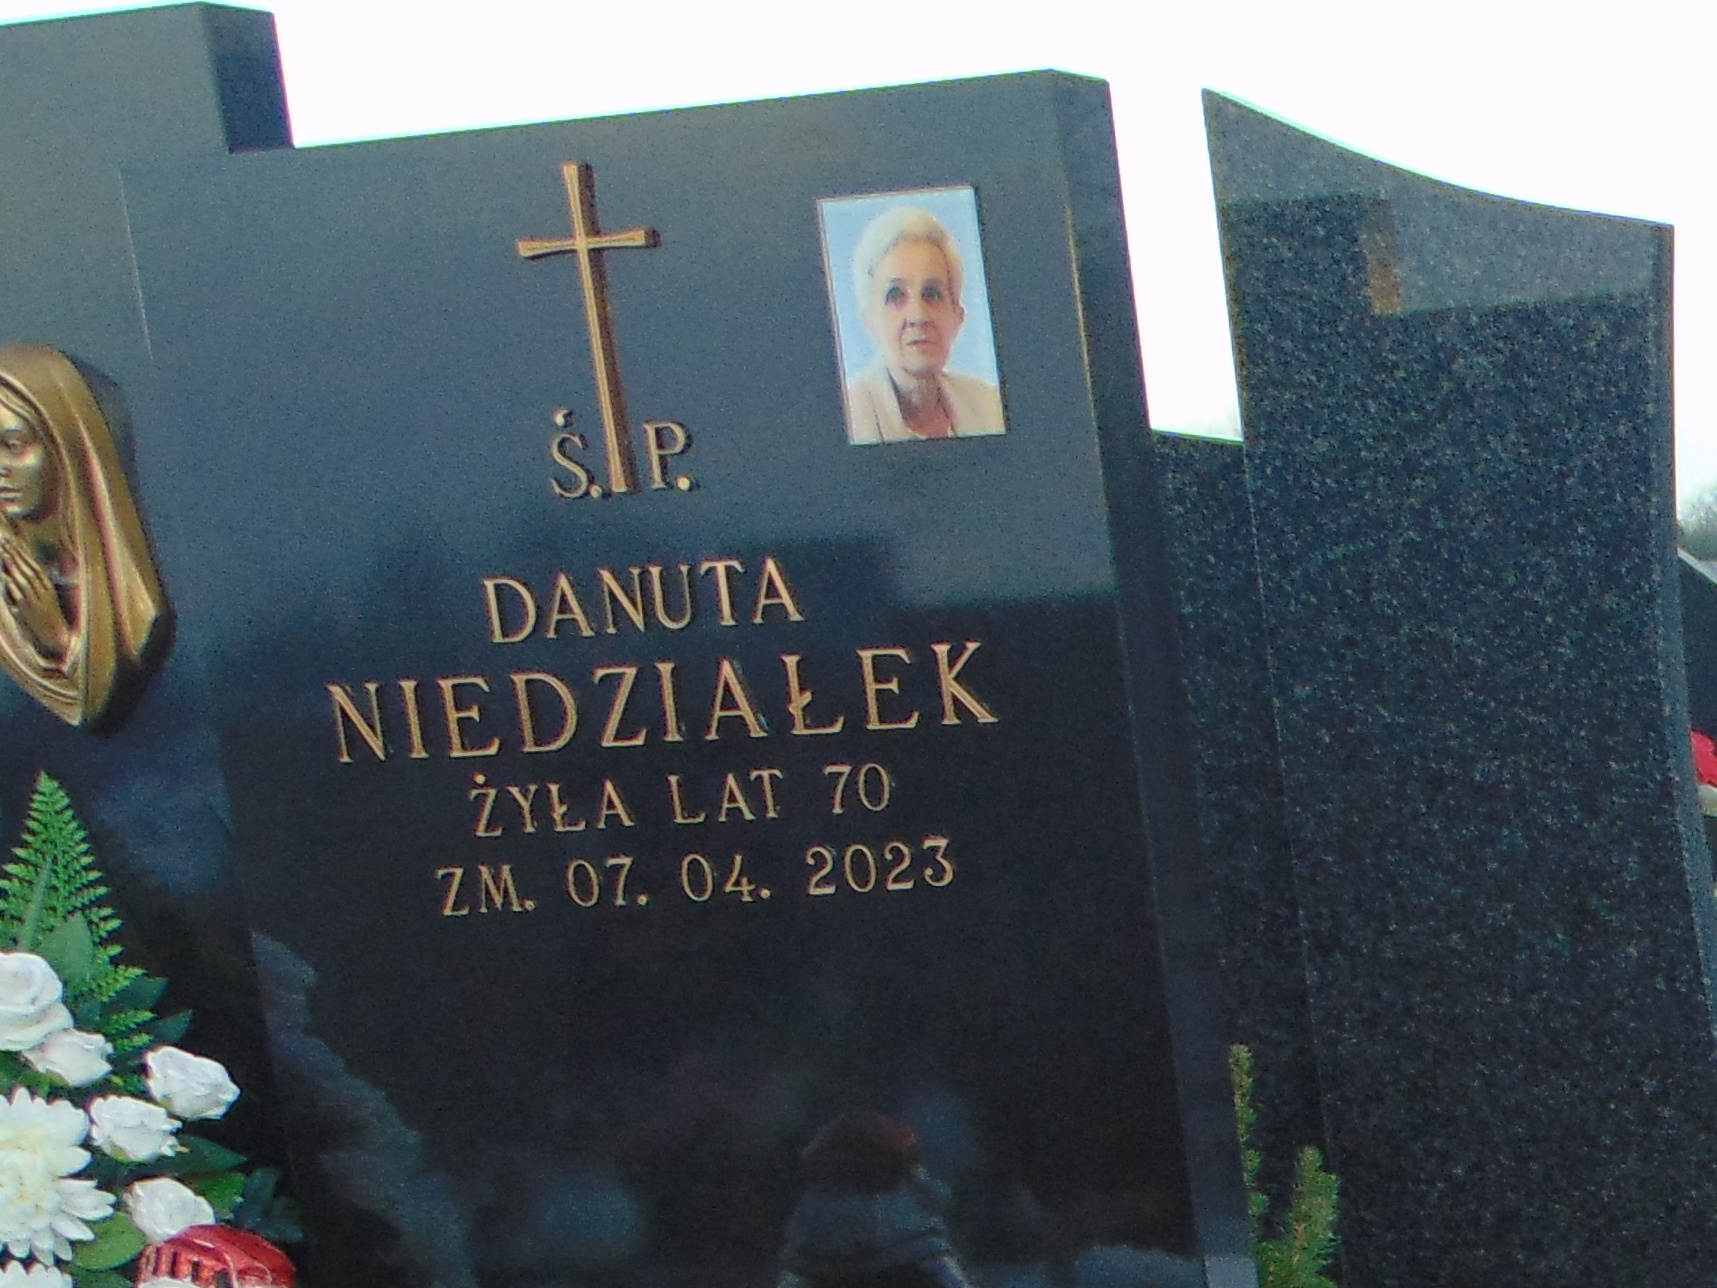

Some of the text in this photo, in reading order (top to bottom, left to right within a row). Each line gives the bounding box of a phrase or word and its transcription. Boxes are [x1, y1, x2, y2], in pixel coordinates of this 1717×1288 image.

[482, 556, 804, 644] DANUTA
[326, 641, 998, 764] NIEDZIAŁEK
[469, 763, 892, 838] ŻYŁA LAT 70
[435, 836, 956, 917] ZM. 07. 04. 2023
